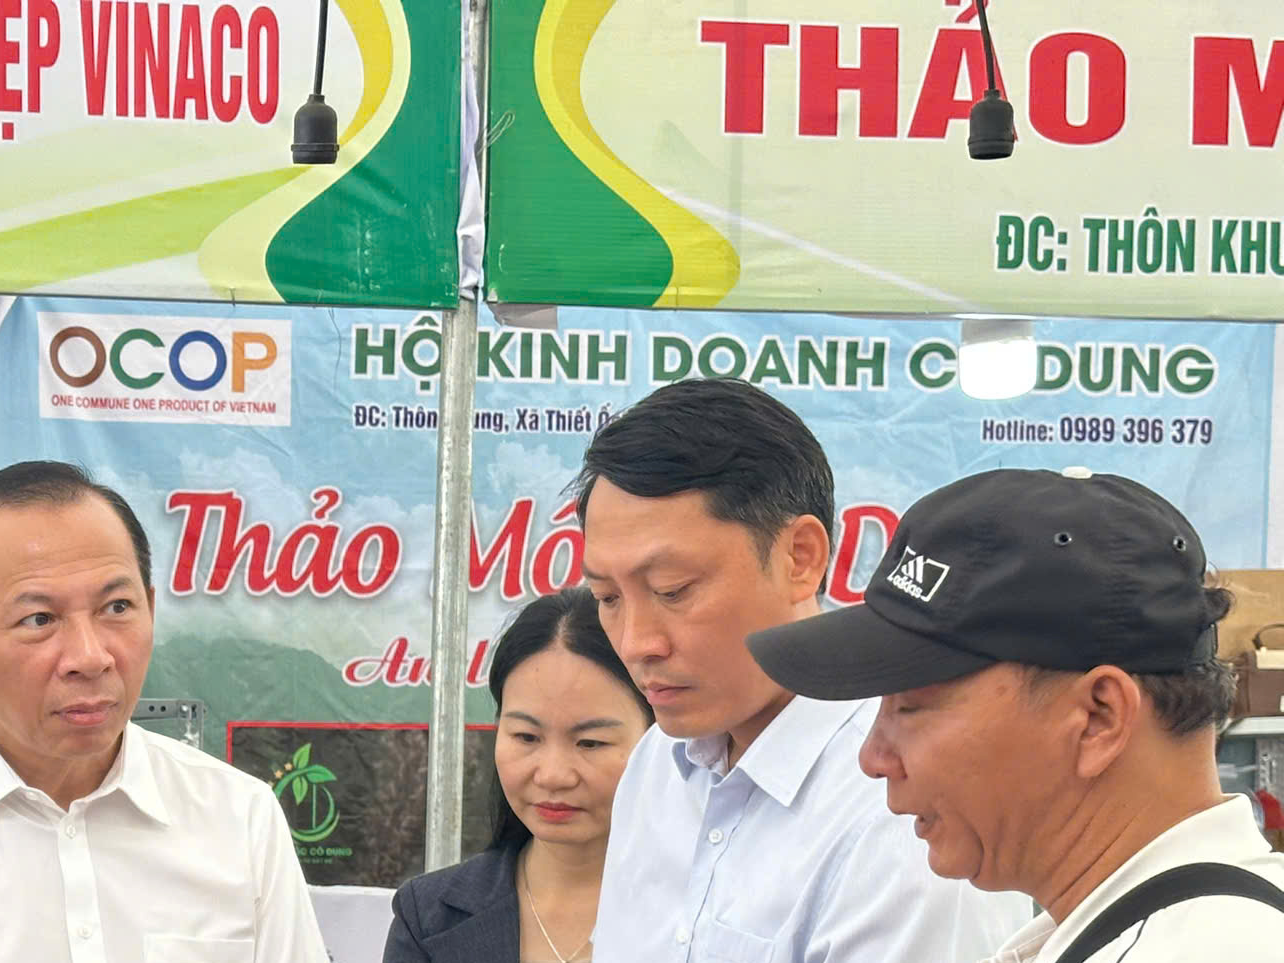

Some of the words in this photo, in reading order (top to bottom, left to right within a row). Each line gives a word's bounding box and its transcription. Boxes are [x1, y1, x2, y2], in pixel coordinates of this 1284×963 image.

[81, 1, 280, 125] VINACO
[996, 214, 1068, 272] ĐC:
[1082, 207, 1196, 273] THÔN
[49, 326, 277, 393] OCOP
[353, 316, 442, 392] HỘ
[474, 328, 628, 382] KINH
[651, 335, 886, 388] DOANH
[1034, 342, 1216, 394] DUNG
[51, 394, 74, 407] ONE
[75, 396, 130, 410] COMMUNE
[132, 398, 156, 410] ONE
[158, 399, 210, 412] PRODUCT
[212, 401, 227, 412] OF
[230, 402, 277, 414] VIETNAM
[354, 404, 387, 428] ĐC:
[392, 405, 438, 429] Thôn
[515, 407, 540, 431] Xã
[545, 404, 592, 432] Thiết
[981, 417, 1055, 443] Hotline:
[1059, 416, 1115, 443] 0989
[1122, 417, 1164, 445] 396
[1170, 418, 1214, 446] 379
[166, 486, 402, 598] Thảo
[892, 574, 923, 599] adidas
